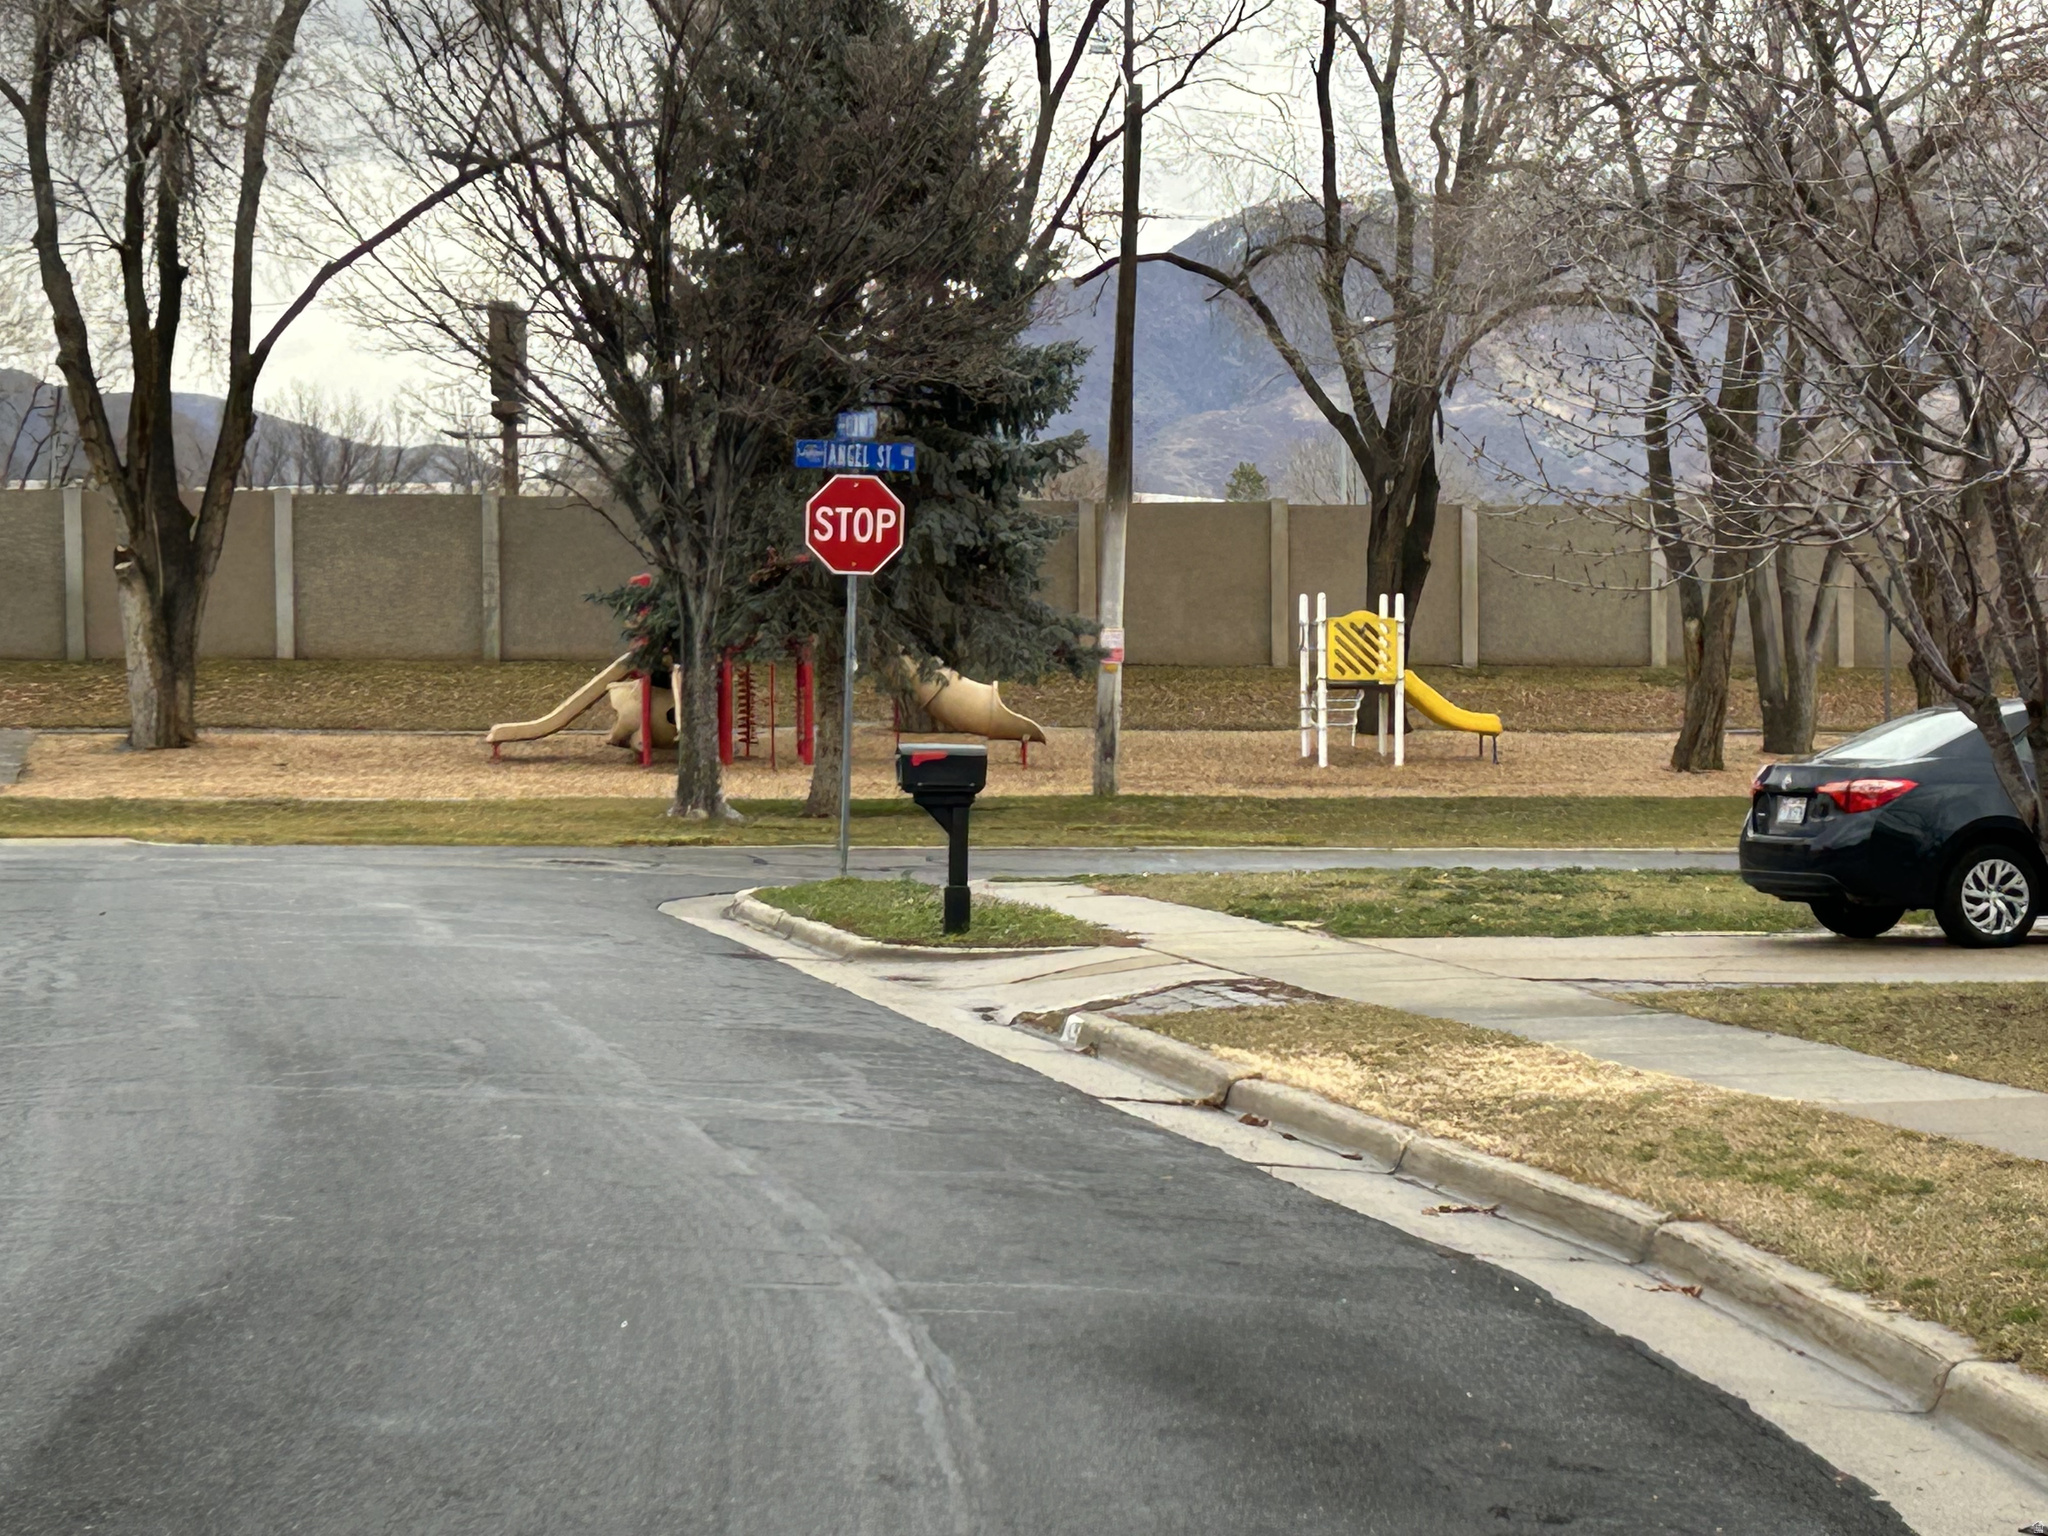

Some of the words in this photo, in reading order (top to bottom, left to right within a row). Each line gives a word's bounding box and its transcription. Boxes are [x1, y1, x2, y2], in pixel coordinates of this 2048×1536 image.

[828, 443, 869, 468] ANGEL
[877, 444, 892, 469] ST
[813, 506, 896, 543] STOP
